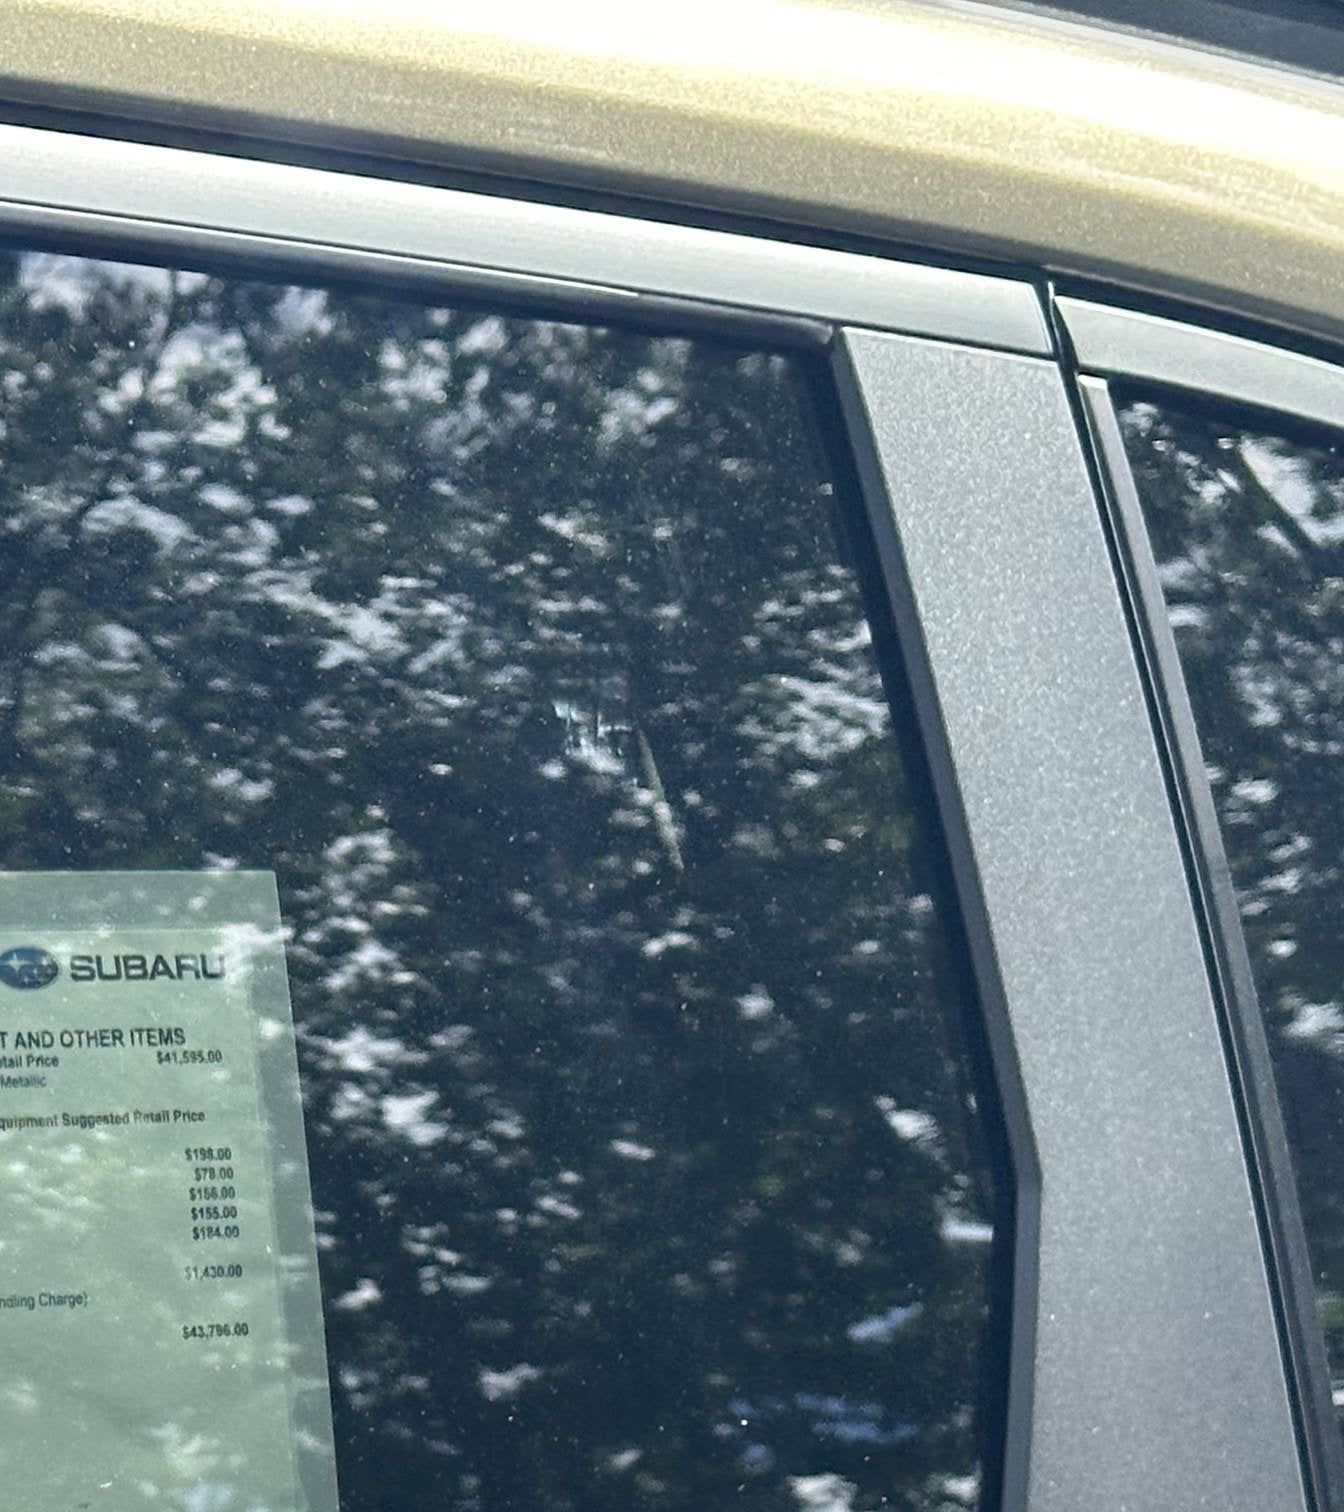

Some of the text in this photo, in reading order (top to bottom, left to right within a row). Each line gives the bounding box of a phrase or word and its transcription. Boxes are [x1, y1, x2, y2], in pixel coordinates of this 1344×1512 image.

[69, 952, 224, 983] SUBARU
[13, 1029, 55, 1050] AND
[58, 1027, 125, 1049] OTHER
[128, 1026, 186, 1047] ITEMS
